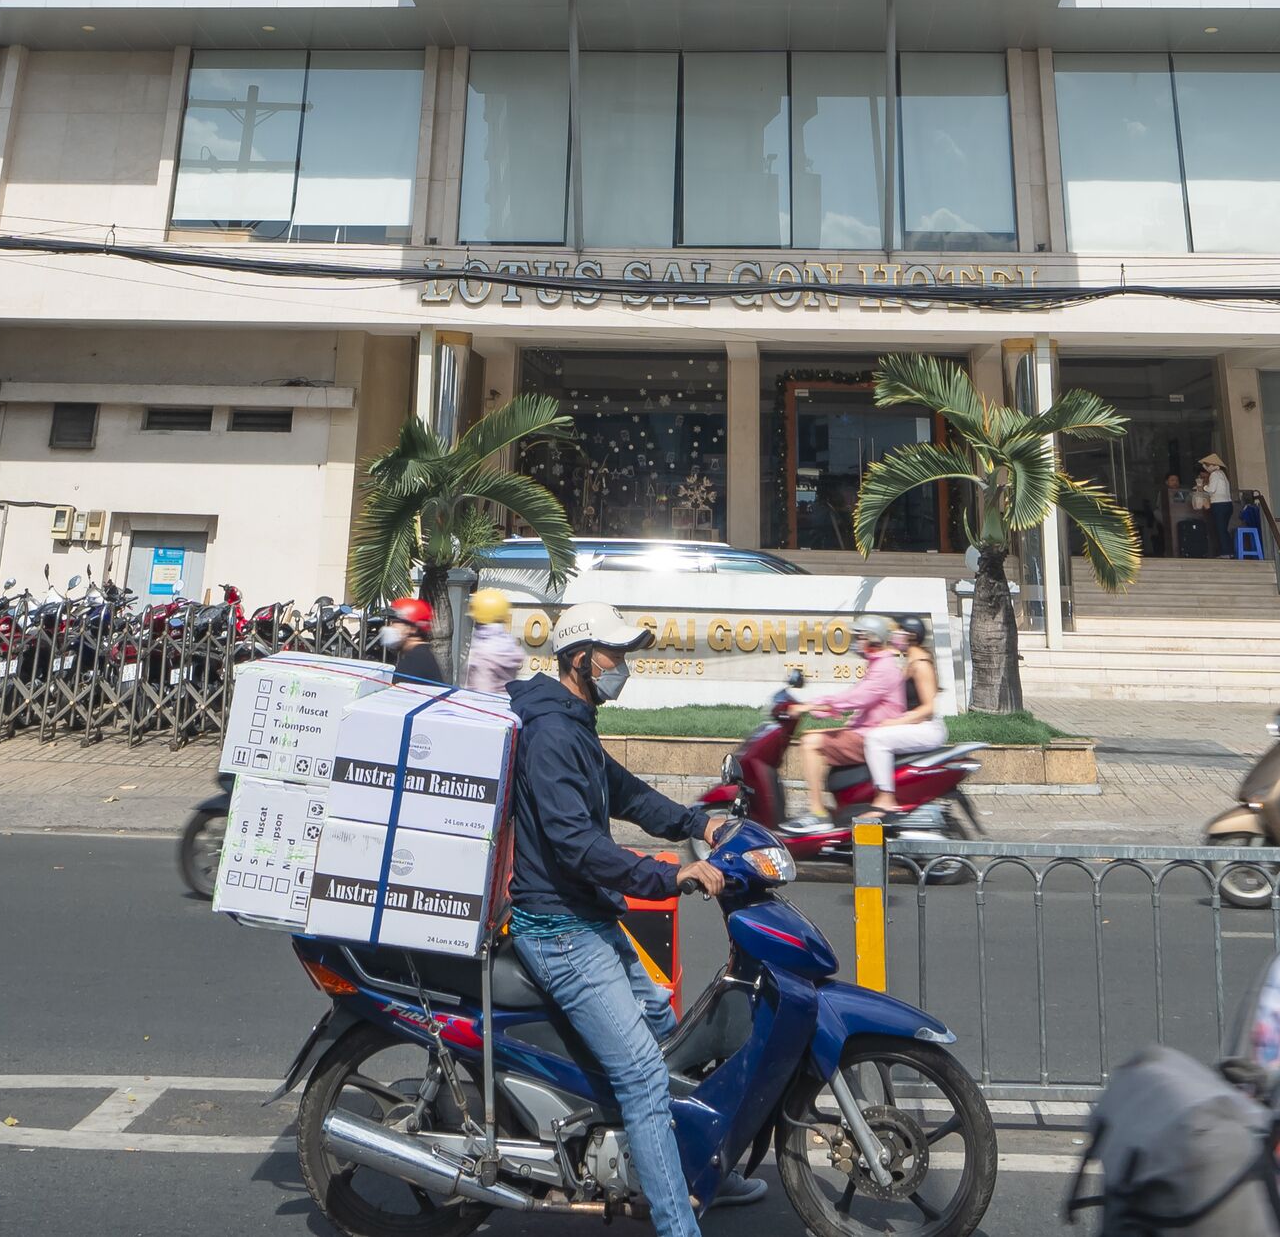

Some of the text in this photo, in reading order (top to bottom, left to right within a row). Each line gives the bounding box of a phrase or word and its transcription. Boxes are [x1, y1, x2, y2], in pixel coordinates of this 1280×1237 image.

[420, 258, 603, 307] LOTUS
[622, 260, 712, 306] SAI
[727, 260, 843, 308] GON
[558, 622, 590, 639] GUCCI
[637, 616, 697, 651] SAI
[707, 618, 787, 654] GON
[696, 659, 705, 675] 3
[834, 664, 852, 679] 28
[344, 761, 486, 800] Austraian Raisins
[454, 819, 464, 827] Lon
[470, 821, 485, 830] 425g
[326, 879, 471, 917] Austraian Raisins
[427, 936, 436, 944] 24
[436, 937, 448, 945] Lon
[454, 939, 469, 949] 425g
